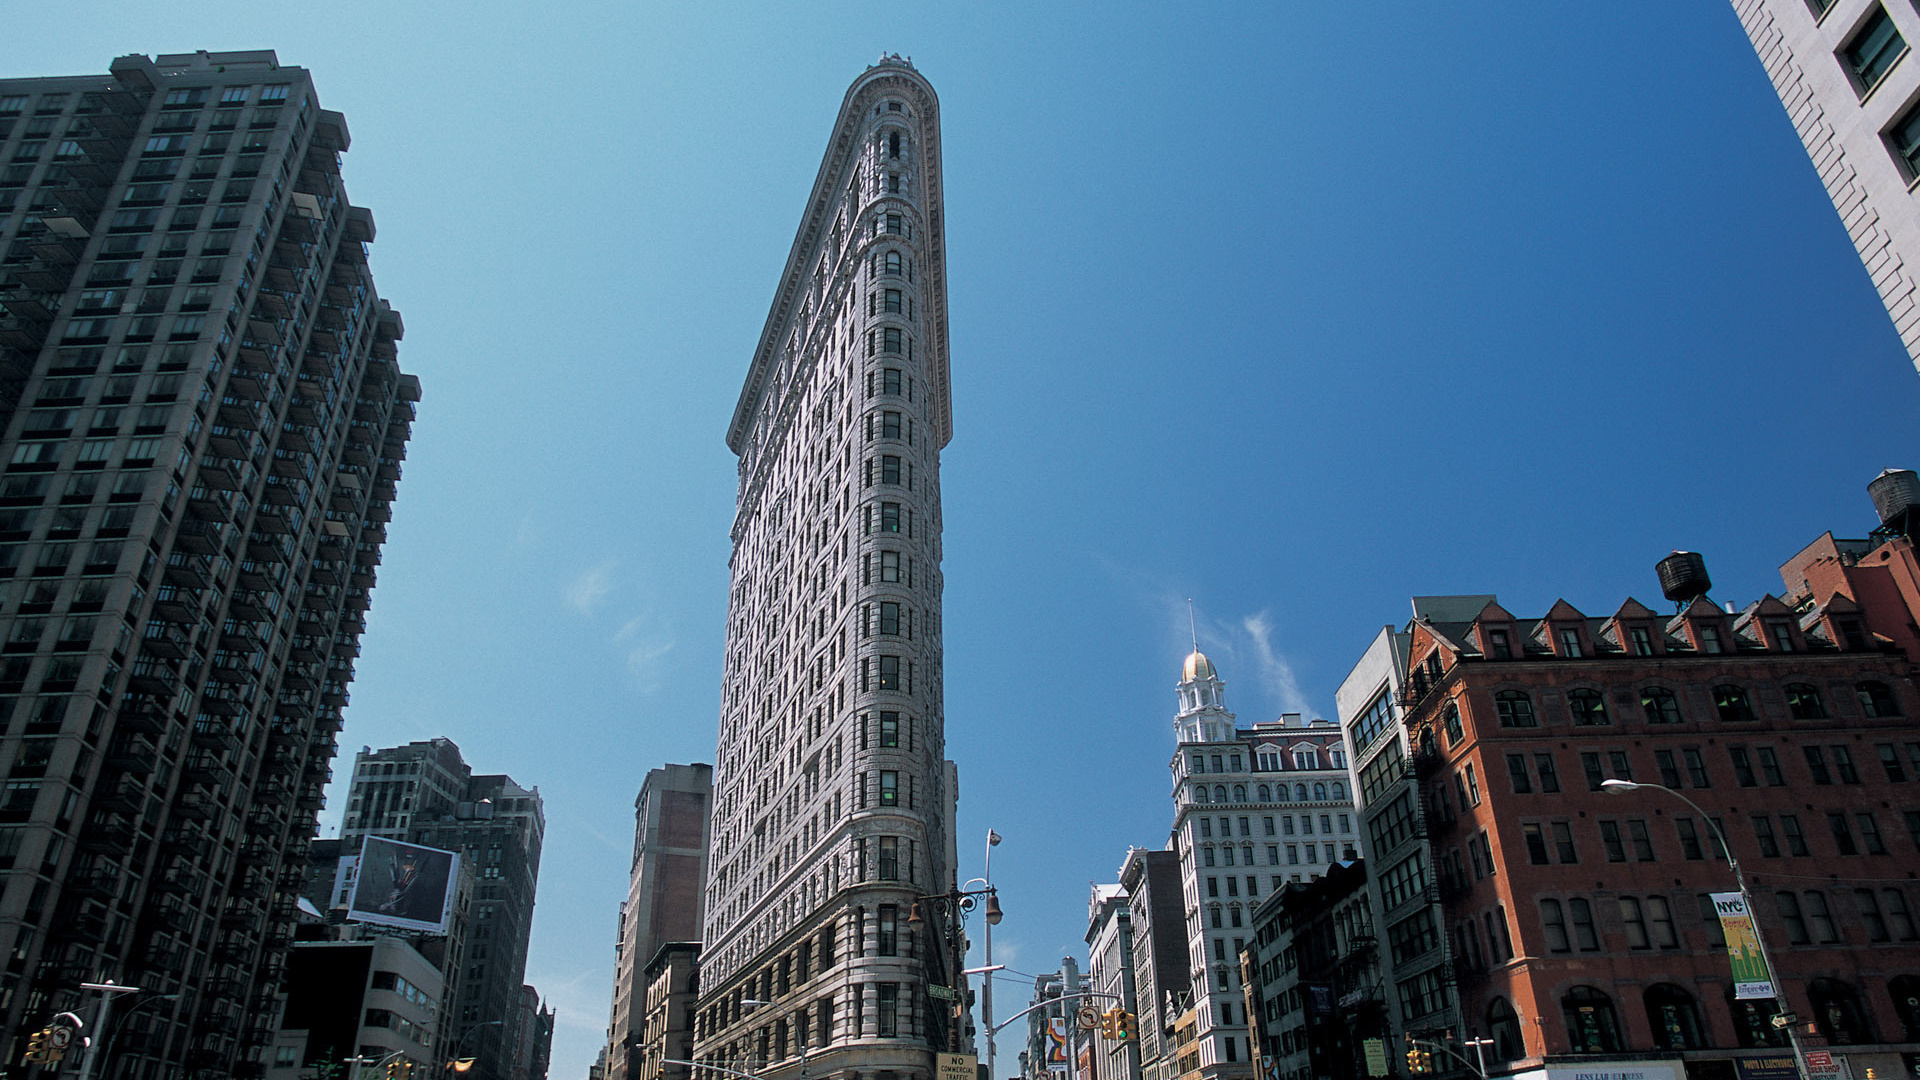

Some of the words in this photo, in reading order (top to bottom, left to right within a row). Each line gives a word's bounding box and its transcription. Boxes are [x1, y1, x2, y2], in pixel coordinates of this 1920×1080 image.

[1716, 899, 1743, 913] NYC
[930, 986, 952, 998] BROADWAY
[1739, 985, 1758, 994] Empire
[951, 1057, 964, 1065] NO
[1743, 1059, 1760, 1070] PHOTO
[941, 1066, 974, 1075] COMMERCIAL
[1824, 1065, 1841, 1074] SHOP
[1612, 1072, 1644, 1080] EXRESS
